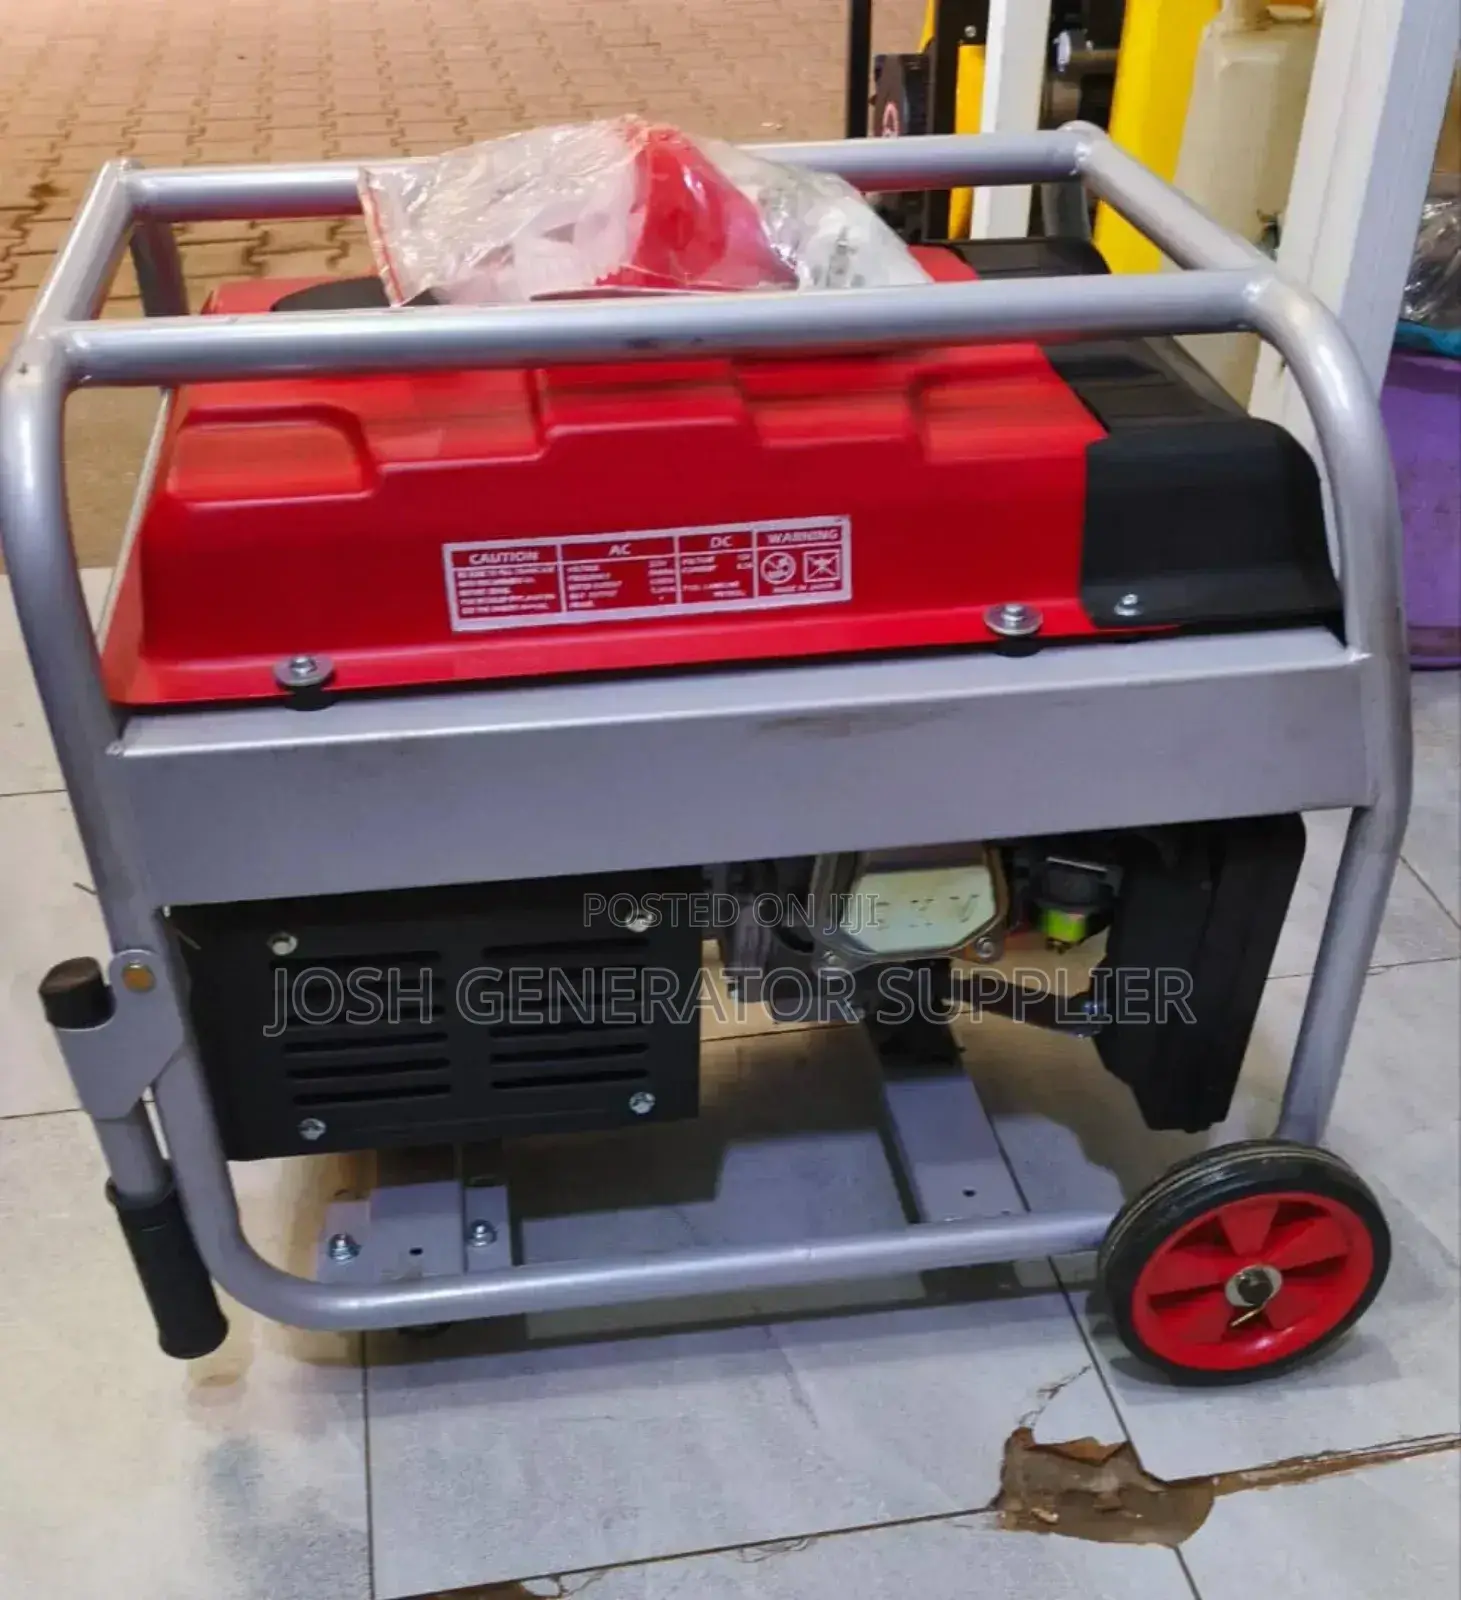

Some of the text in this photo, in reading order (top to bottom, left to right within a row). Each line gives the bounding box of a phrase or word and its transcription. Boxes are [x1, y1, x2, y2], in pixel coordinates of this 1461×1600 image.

[710, 536, 733, 548] DC
[767, 529, 838, 544] WARNING
[609, 543, 631, 556] AC
[469, 551, 539, 565] CAUTION
